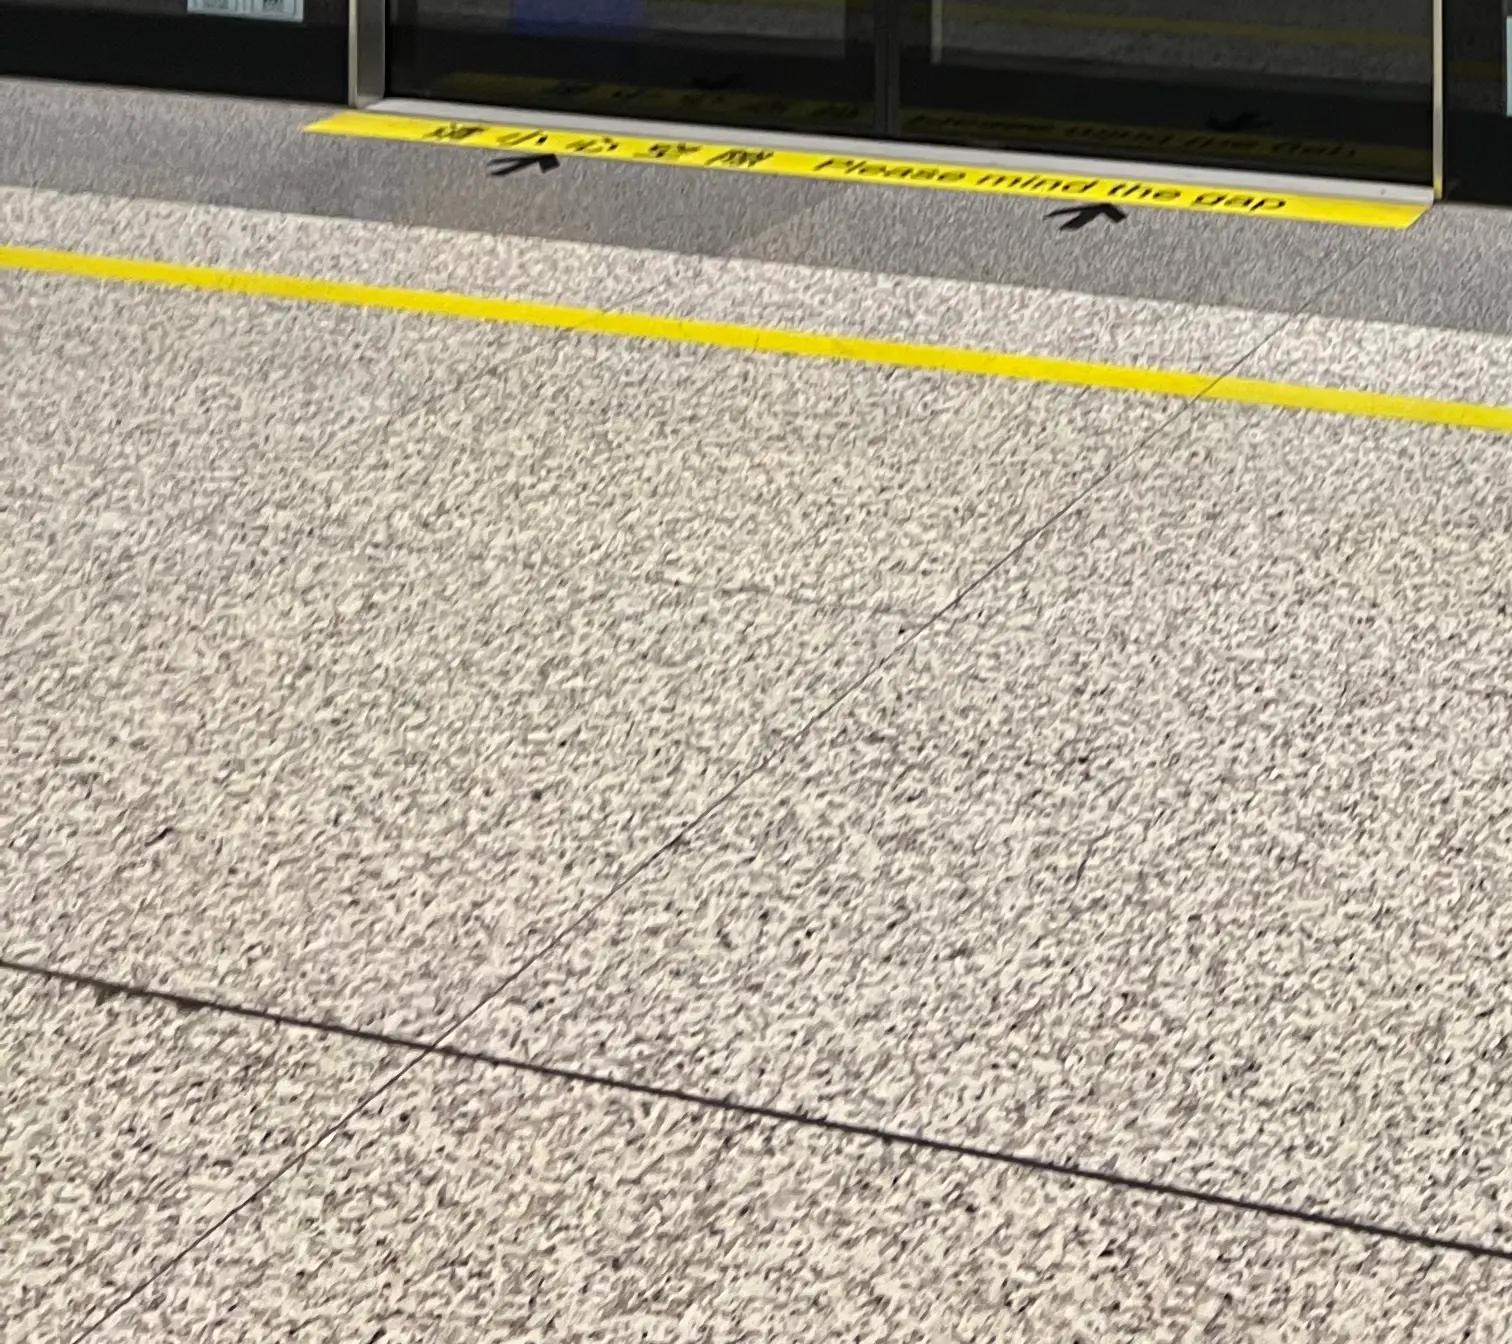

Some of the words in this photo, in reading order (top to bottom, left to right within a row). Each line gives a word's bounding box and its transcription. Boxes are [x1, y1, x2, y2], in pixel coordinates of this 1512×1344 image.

[812, 157, 967, 184] Please
[975, 170, 1101, 194] mind
[1107, 181, 1182, 202] the
[1192, 191, 1287, 213] gap
